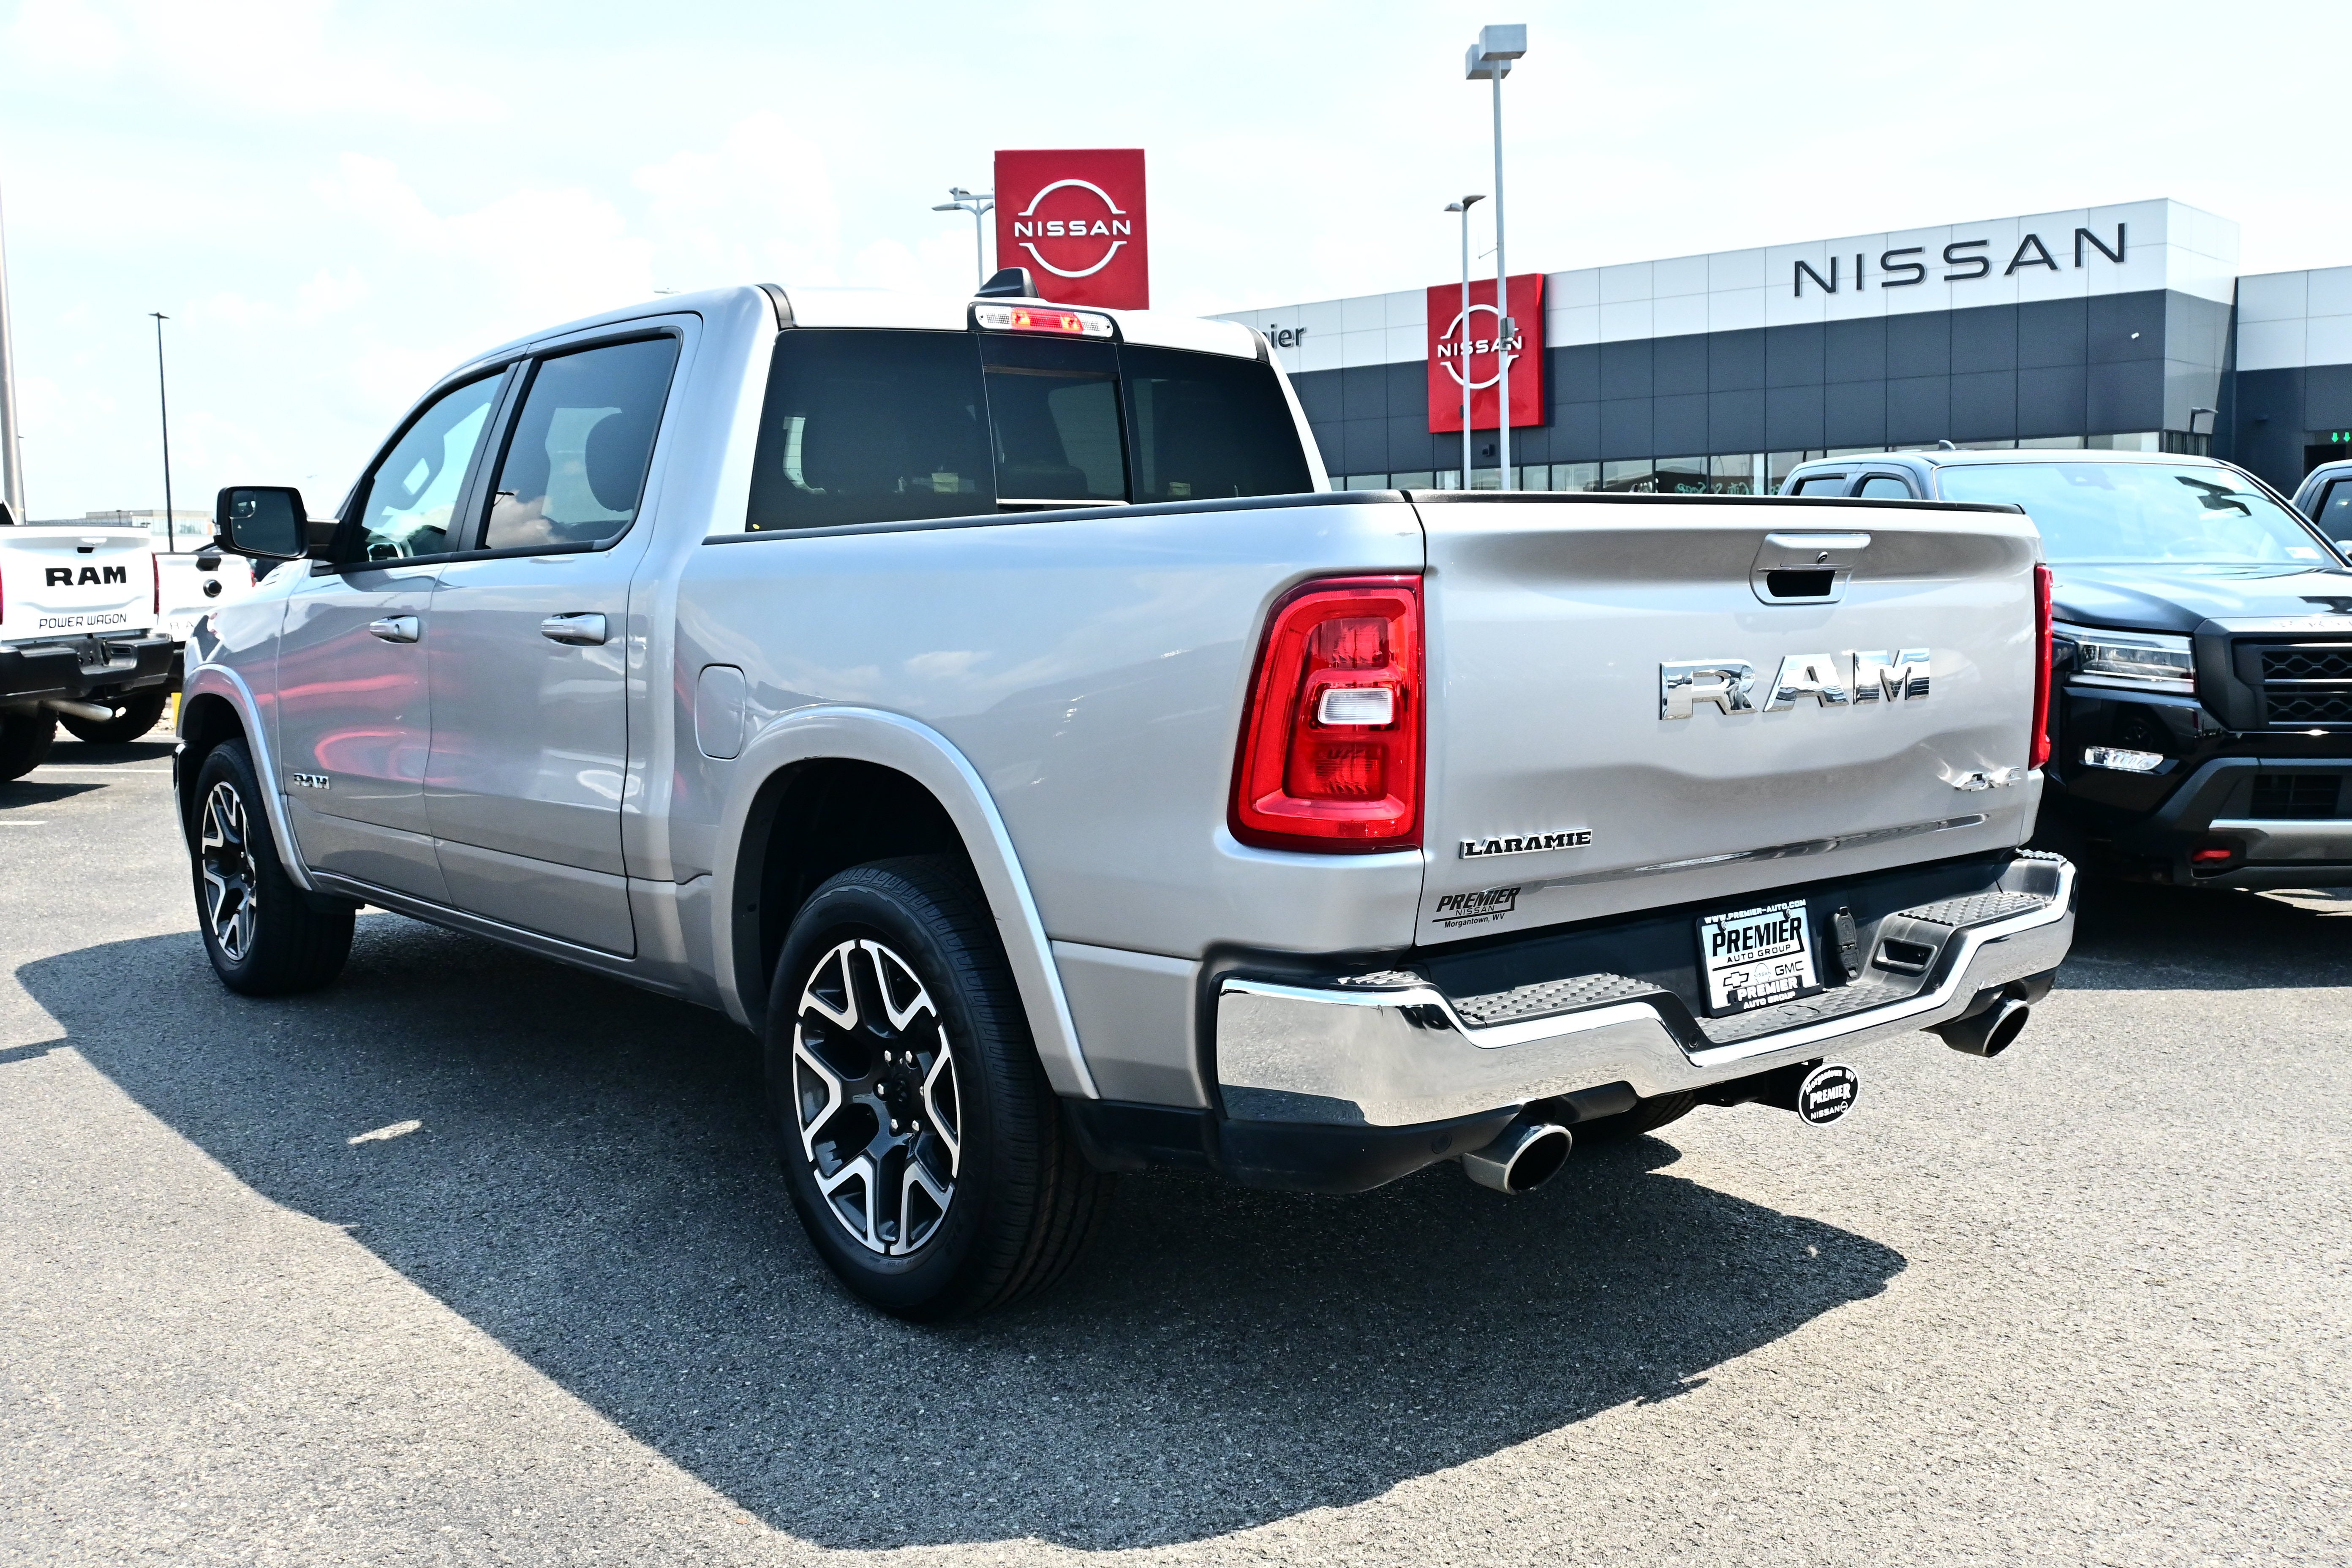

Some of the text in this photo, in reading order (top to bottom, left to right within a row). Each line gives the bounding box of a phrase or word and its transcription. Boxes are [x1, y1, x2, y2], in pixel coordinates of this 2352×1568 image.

[1014, 220, 1130, 237] NISSAN
[1794, 222, 2126, 297] NISSAN
[1262, 323, 1306, 349] ier
[45, 566, 126, 586] RAM
[39, 613, 126, 629] POWER WAGON
[1659, 647, 1930, 721] RAM
[1461, 829, 1592, 858] LARAMIE
[1437, 887, 1521, 912] PREMIER
[1456, 905, 1495, 916] NISSAN
[1704, 899, 1806, 924] WWW.PREMIER-AUTO.COM
[1444, 913, 1505, 928] Morgantown, WV
[1712, 917, 1804, 957] PREMIER
[1727, 944, 1791, 963] AUTO GROUP
[1775, 961, 1804, 976] GMC
[1737, 977, 1798, 1002] PREMIER
[1743, 991, 1796, 1009] AUTO GROUP
[1805, 1069, 1856, 1095] Morgantown WV
[1810, 1083, 1851, 1109] PREMIER
[1810, 1105, 1840, 1120] NISSAN
